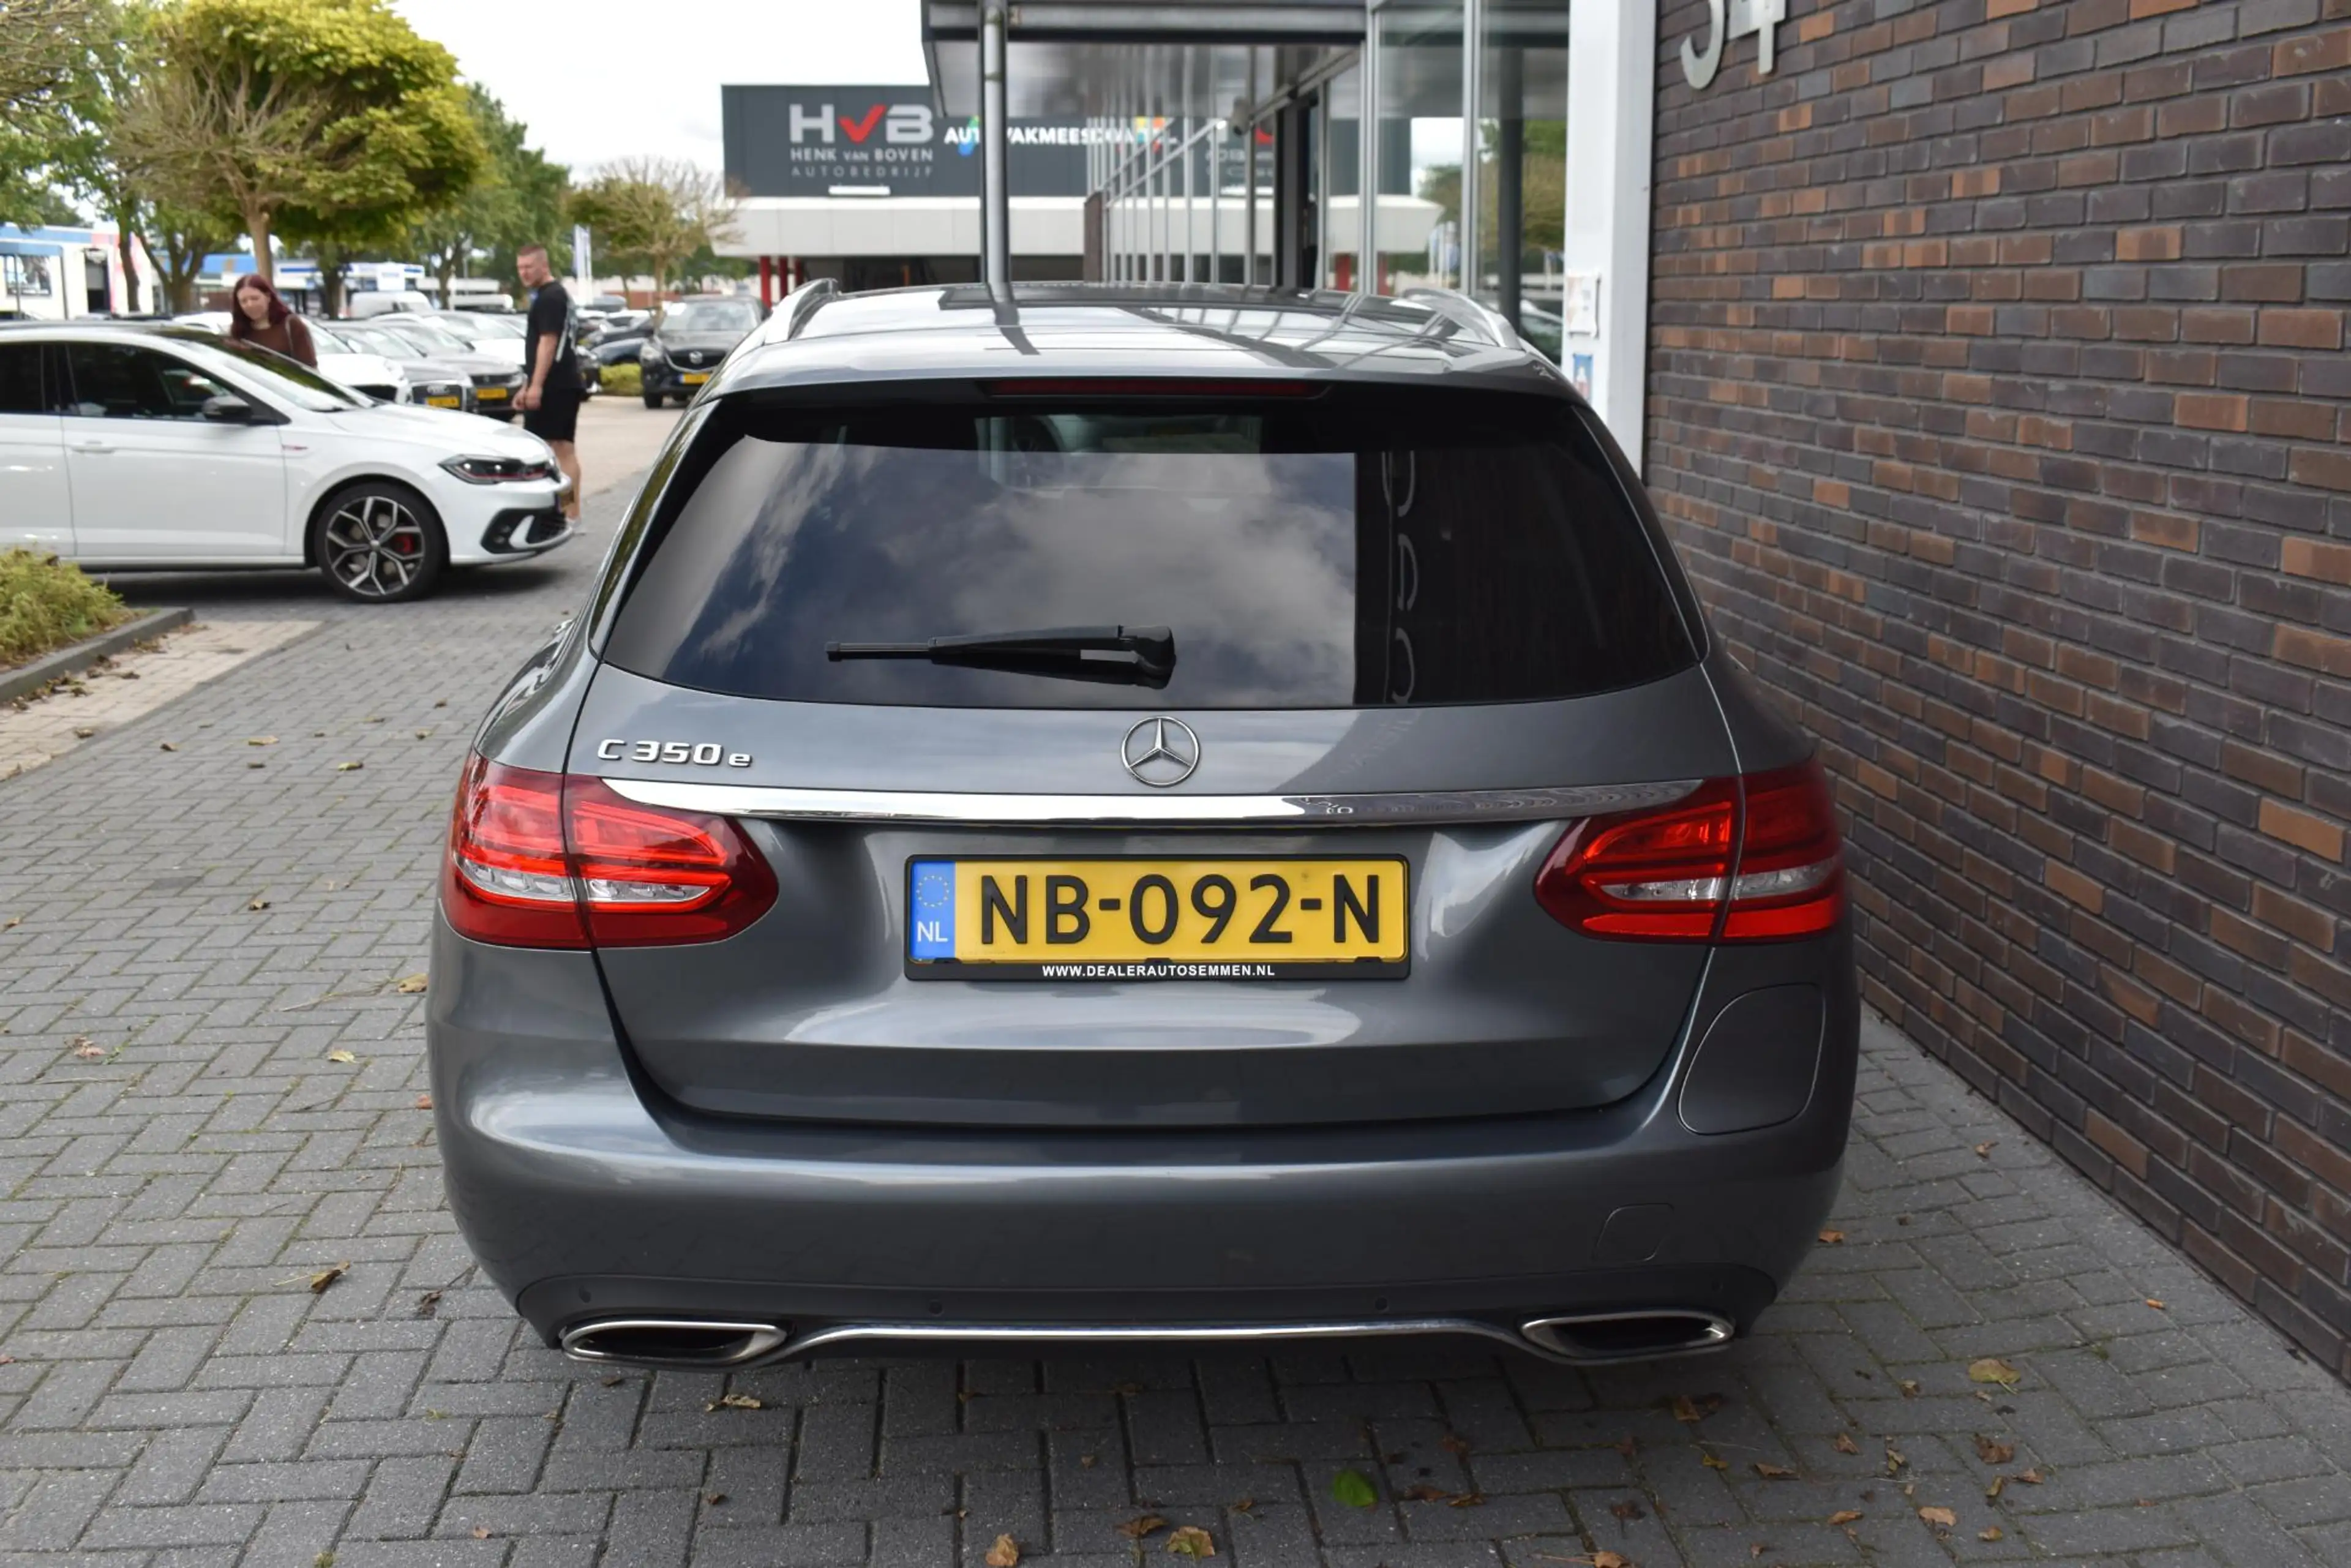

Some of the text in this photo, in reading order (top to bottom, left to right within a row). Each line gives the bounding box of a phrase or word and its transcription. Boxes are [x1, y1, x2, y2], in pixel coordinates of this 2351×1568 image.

[790, 148, 836, 162] HENK
[874, 148, 933, 162] BOVEN
[791, 165, 932, 178] AUTOBEDRIJF
[598, 739, 627, 760] C
[631, 740, 724, 765] 350
[981, 874, 1379, 944] NB-092-N
[917, 921, 948, 942] NL
[1041, 964, 1275, 977] WWW.DEALERAUTOSEMMEN.NL
